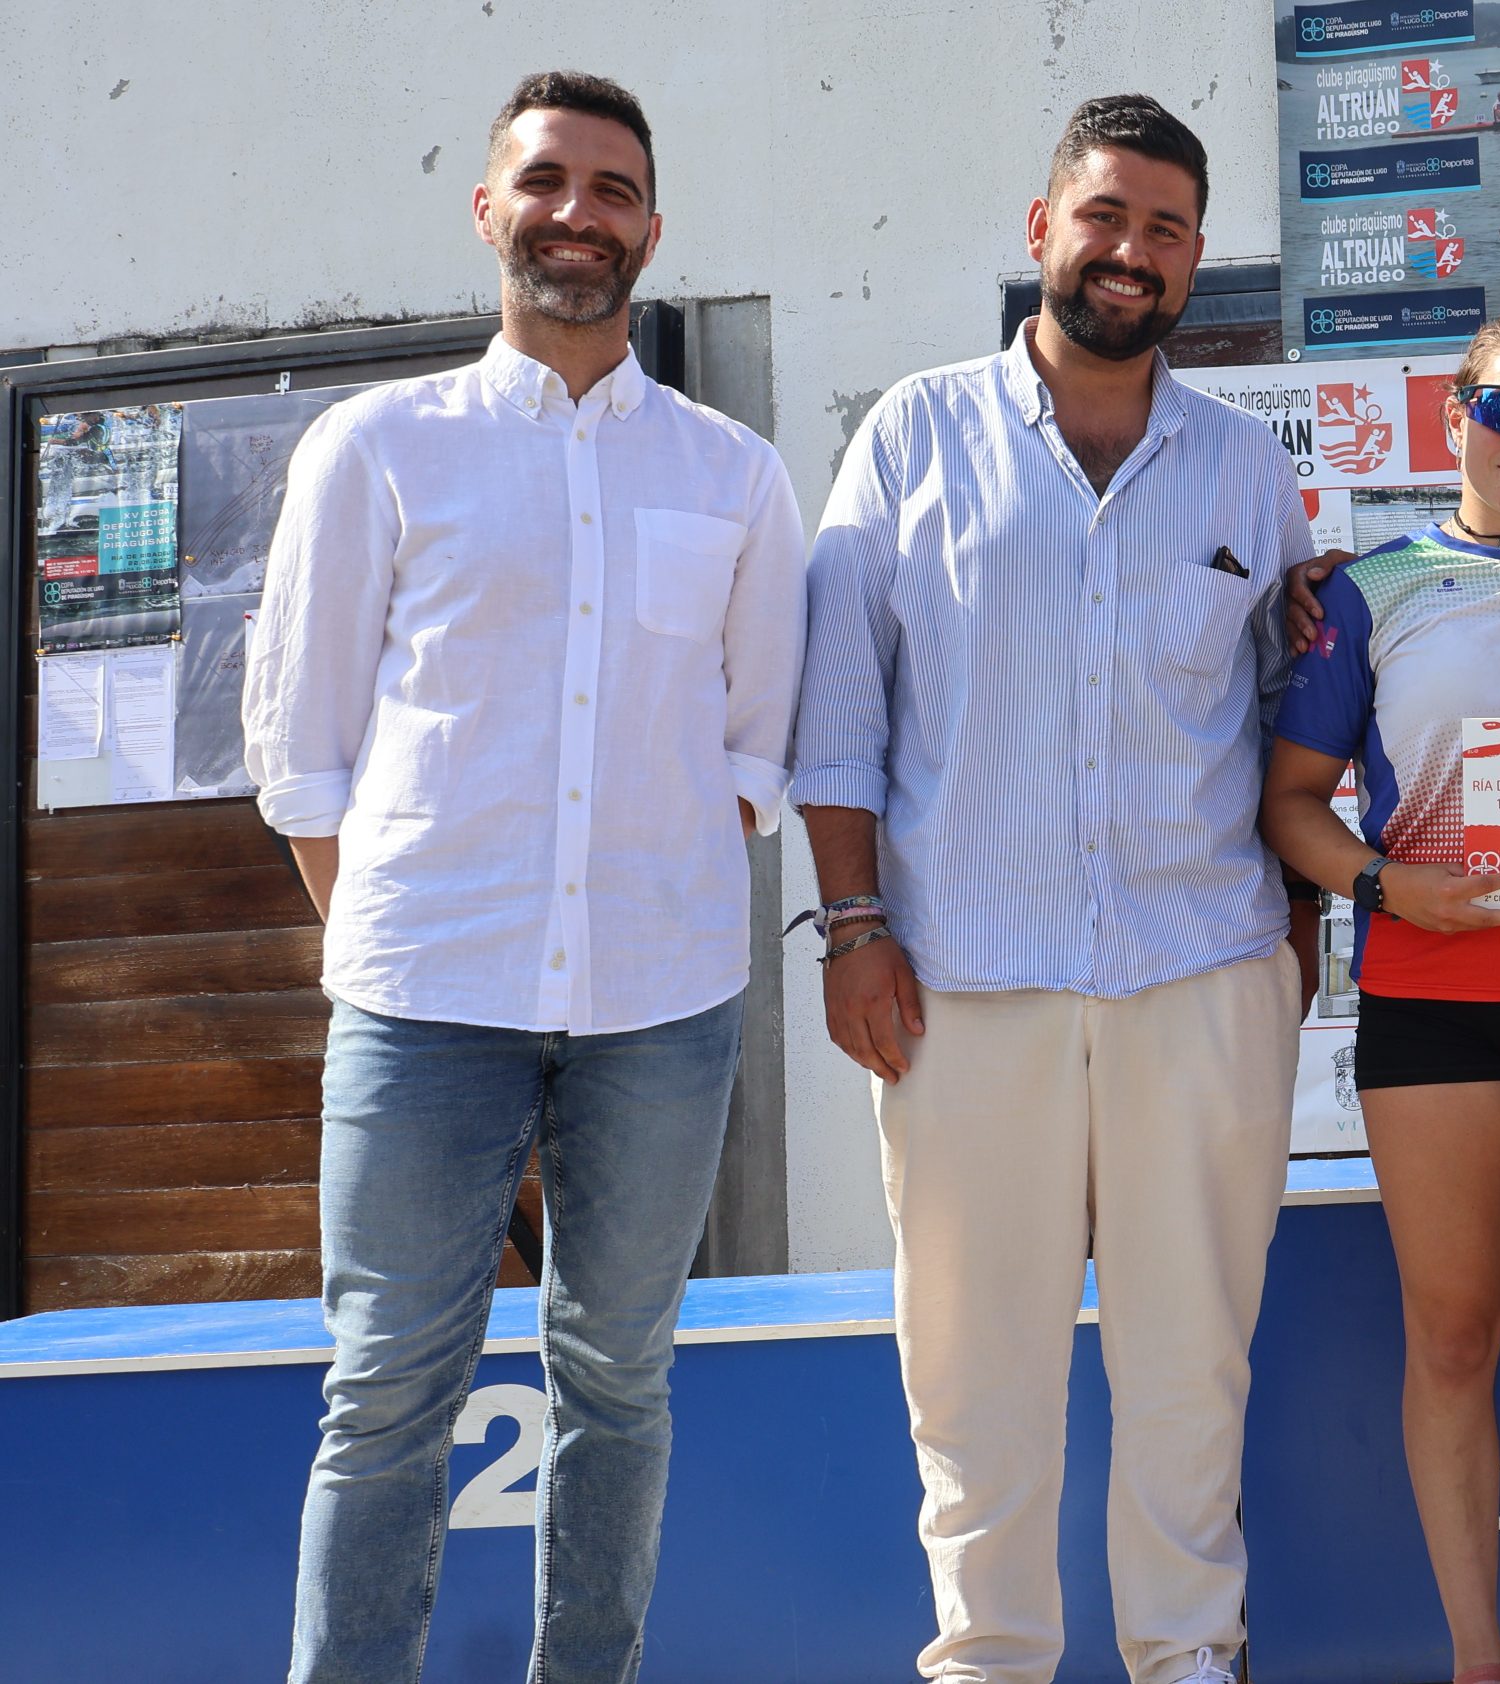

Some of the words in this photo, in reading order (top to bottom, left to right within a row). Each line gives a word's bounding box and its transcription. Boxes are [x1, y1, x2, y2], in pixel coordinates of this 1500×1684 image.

[1435, 9, 1469, 20] Deportes
[1326, 16, 1343, 25] COPA
[1368, 20, 1382, 28] LUGO
[1317, 63, 1343, 88] clube
[1345, 62, 1397, 90] piragüismo
[1317, 81, 1400, 124] ALTRUÁN
[1317, 119, 1400, 140] ribadeo
[1331, 163, 1348, 172] COPA
[1440, 158, 1474, 169] Deportes
[1373, 167, 1388, 175] LUGO
[1321, 215, 1347, 236] clube
[1350, 211, 1403, 237] piragüismo
[1321, 231, 1405, 271] ALTRUÁN
[1321, 267, 1406, 287] ribadeo
[1335, 309, 1353, 317] COPA
[1378, 314, 1393, 322] LUGO
[1447, 308, 1481, 319] Deportes
[1239, 382, 1312, 417] piragüismo
[106, 533, 120, 541] DE
[124, 529, 153, 538] LUGO
[1331, 526, 1342, 535] 46
[1472, 777, 1493, 792] RÍA
[449, 1383, 551, 1530] 2
